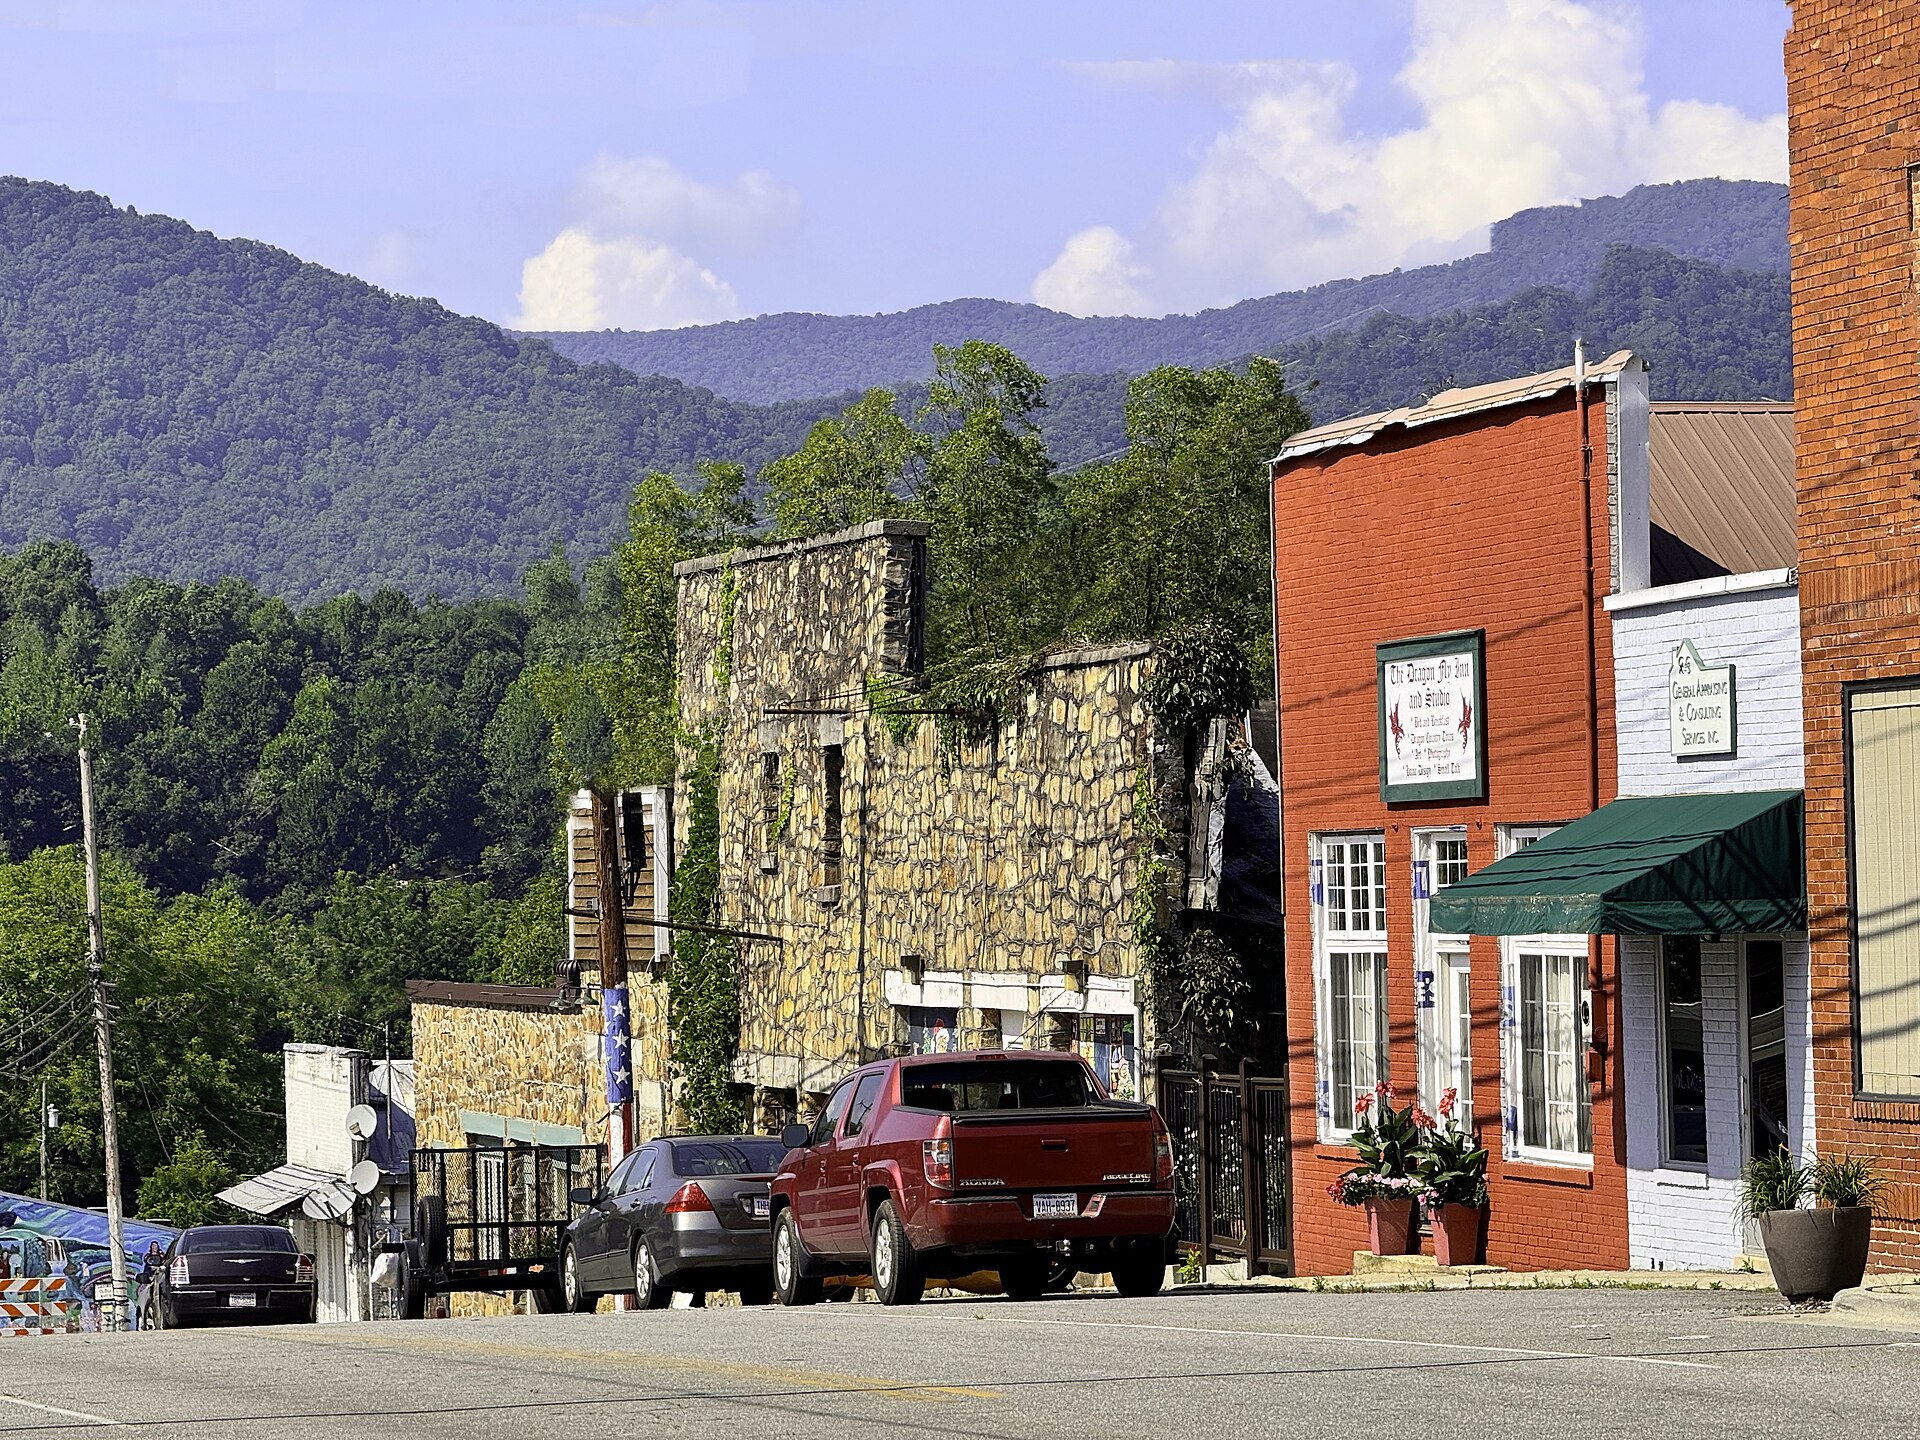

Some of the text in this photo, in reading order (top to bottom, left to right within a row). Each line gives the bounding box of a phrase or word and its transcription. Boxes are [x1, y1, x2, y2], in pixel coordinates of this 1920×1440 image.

[1390, 657, 1469, 687] The Dragon Fly Inn
[1409, 687, 1450, 709] and Studio
[1679, 706, 1685, 722] &
[1414, 716, 1422, 728] Bed
[959, 1178, 1006, 1186] HONDA
[1036, 1199, 1075, 1213] VAH-8937
